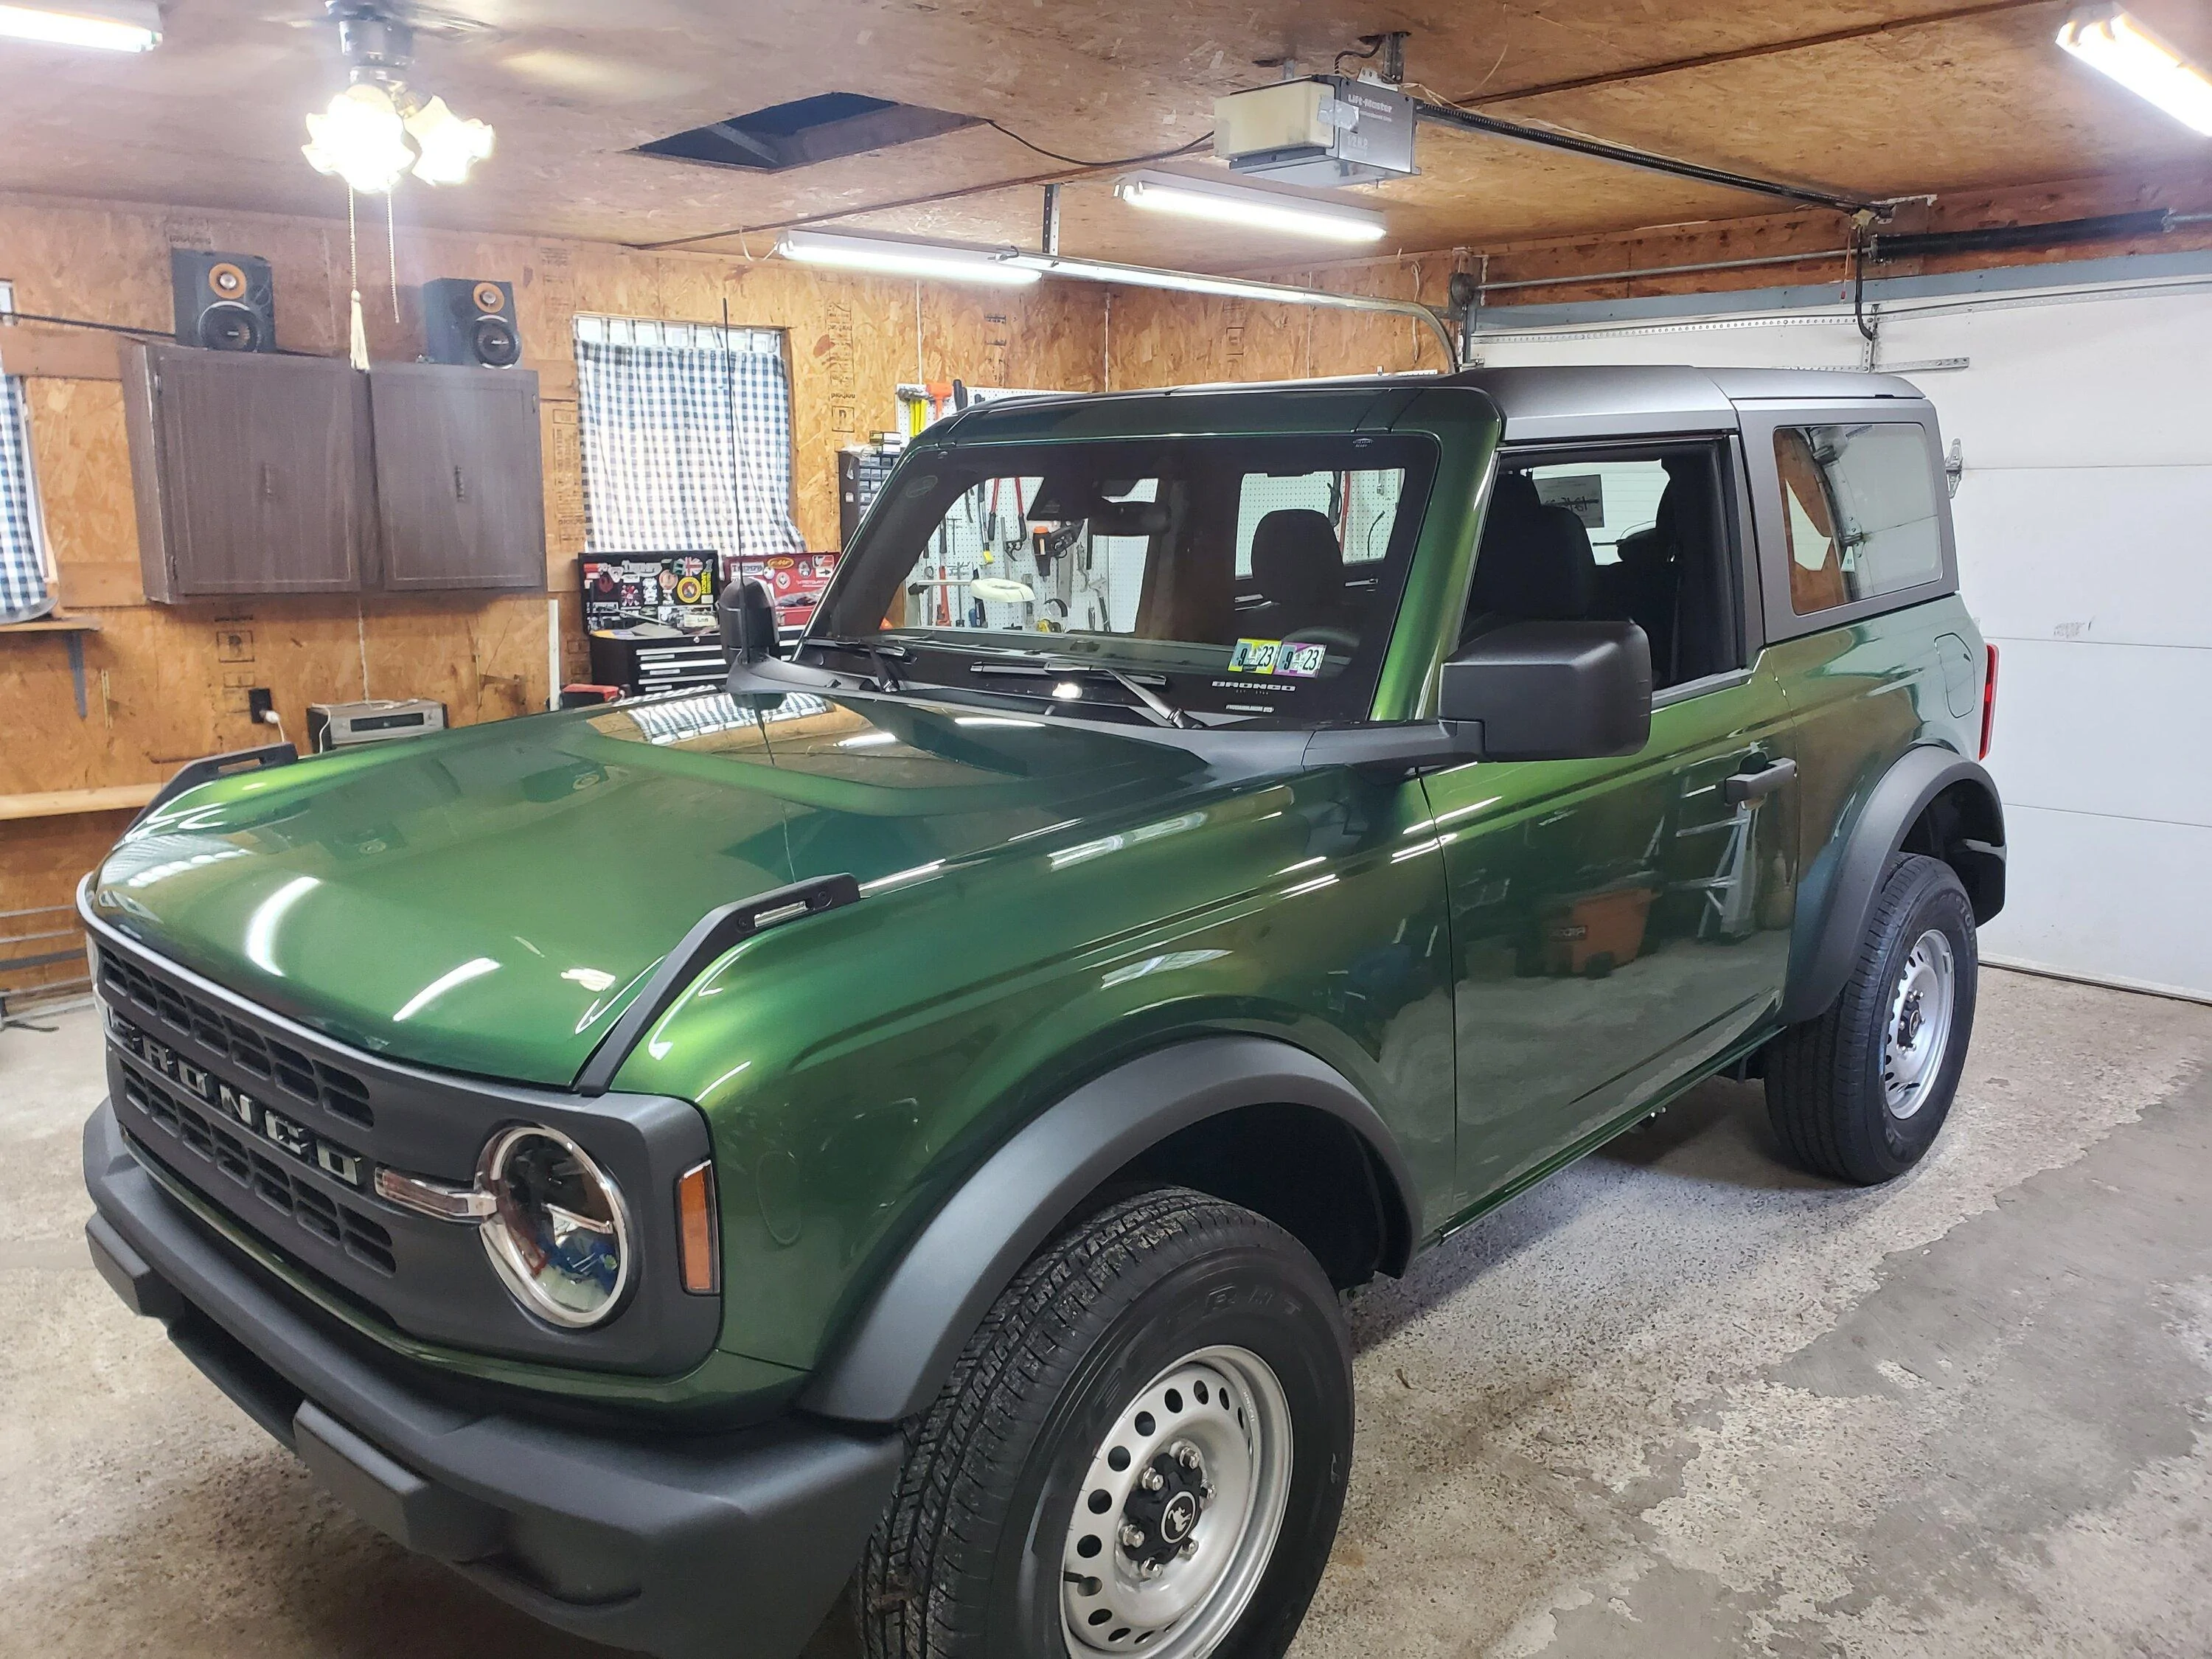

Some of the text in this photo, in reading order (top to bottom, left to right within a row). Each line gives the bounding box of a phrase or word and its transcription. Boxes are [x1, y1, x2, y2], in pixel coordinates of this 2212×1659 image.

[1238, 645, 1275, 667] 9 23
[1283, 649, 1320, 671] 9 23
[1211, 681, 1296, 692] BRONCO
